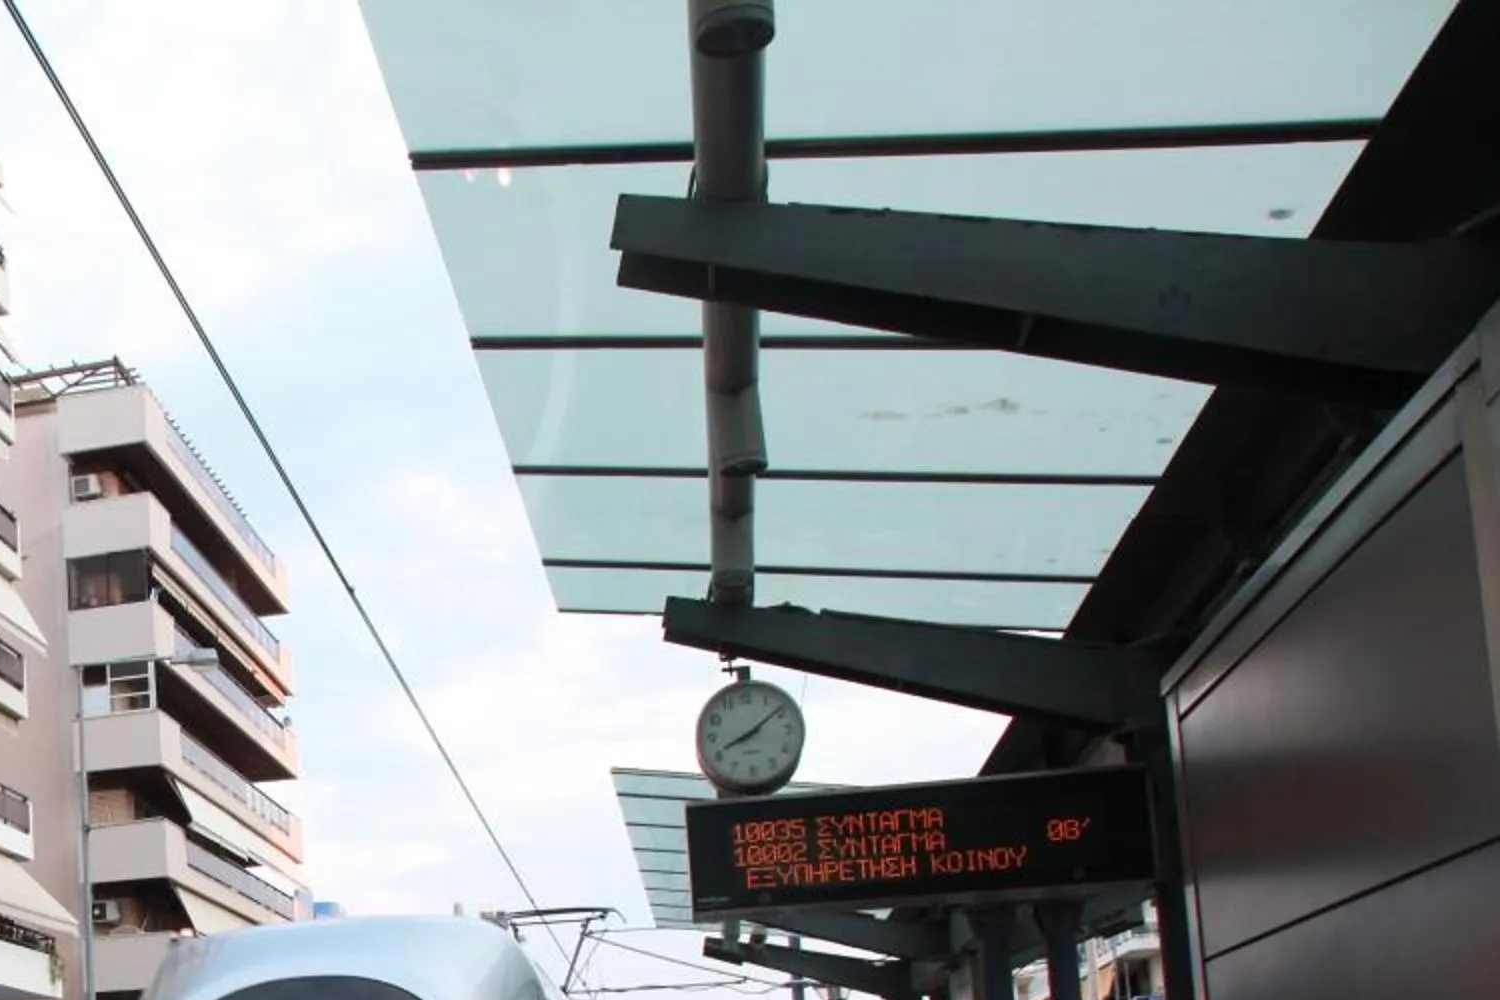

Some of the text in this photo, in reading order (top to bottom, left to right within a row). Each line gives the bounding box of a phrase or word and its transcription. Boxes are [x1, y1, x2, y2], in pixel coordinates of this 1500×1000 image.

[734, 806, 944, 845] 10035 ΣΥΝΤΑΓΜΑ
[734, 842, 808, 867] 10002
[817, 831, 946, 861] ΣΥΝΤΑΓΜΑ
[747, 845, 1028, 889] ΕΞΥΠΗΡΕΤΗΣΗ ΚΟΙΝΟΥ
